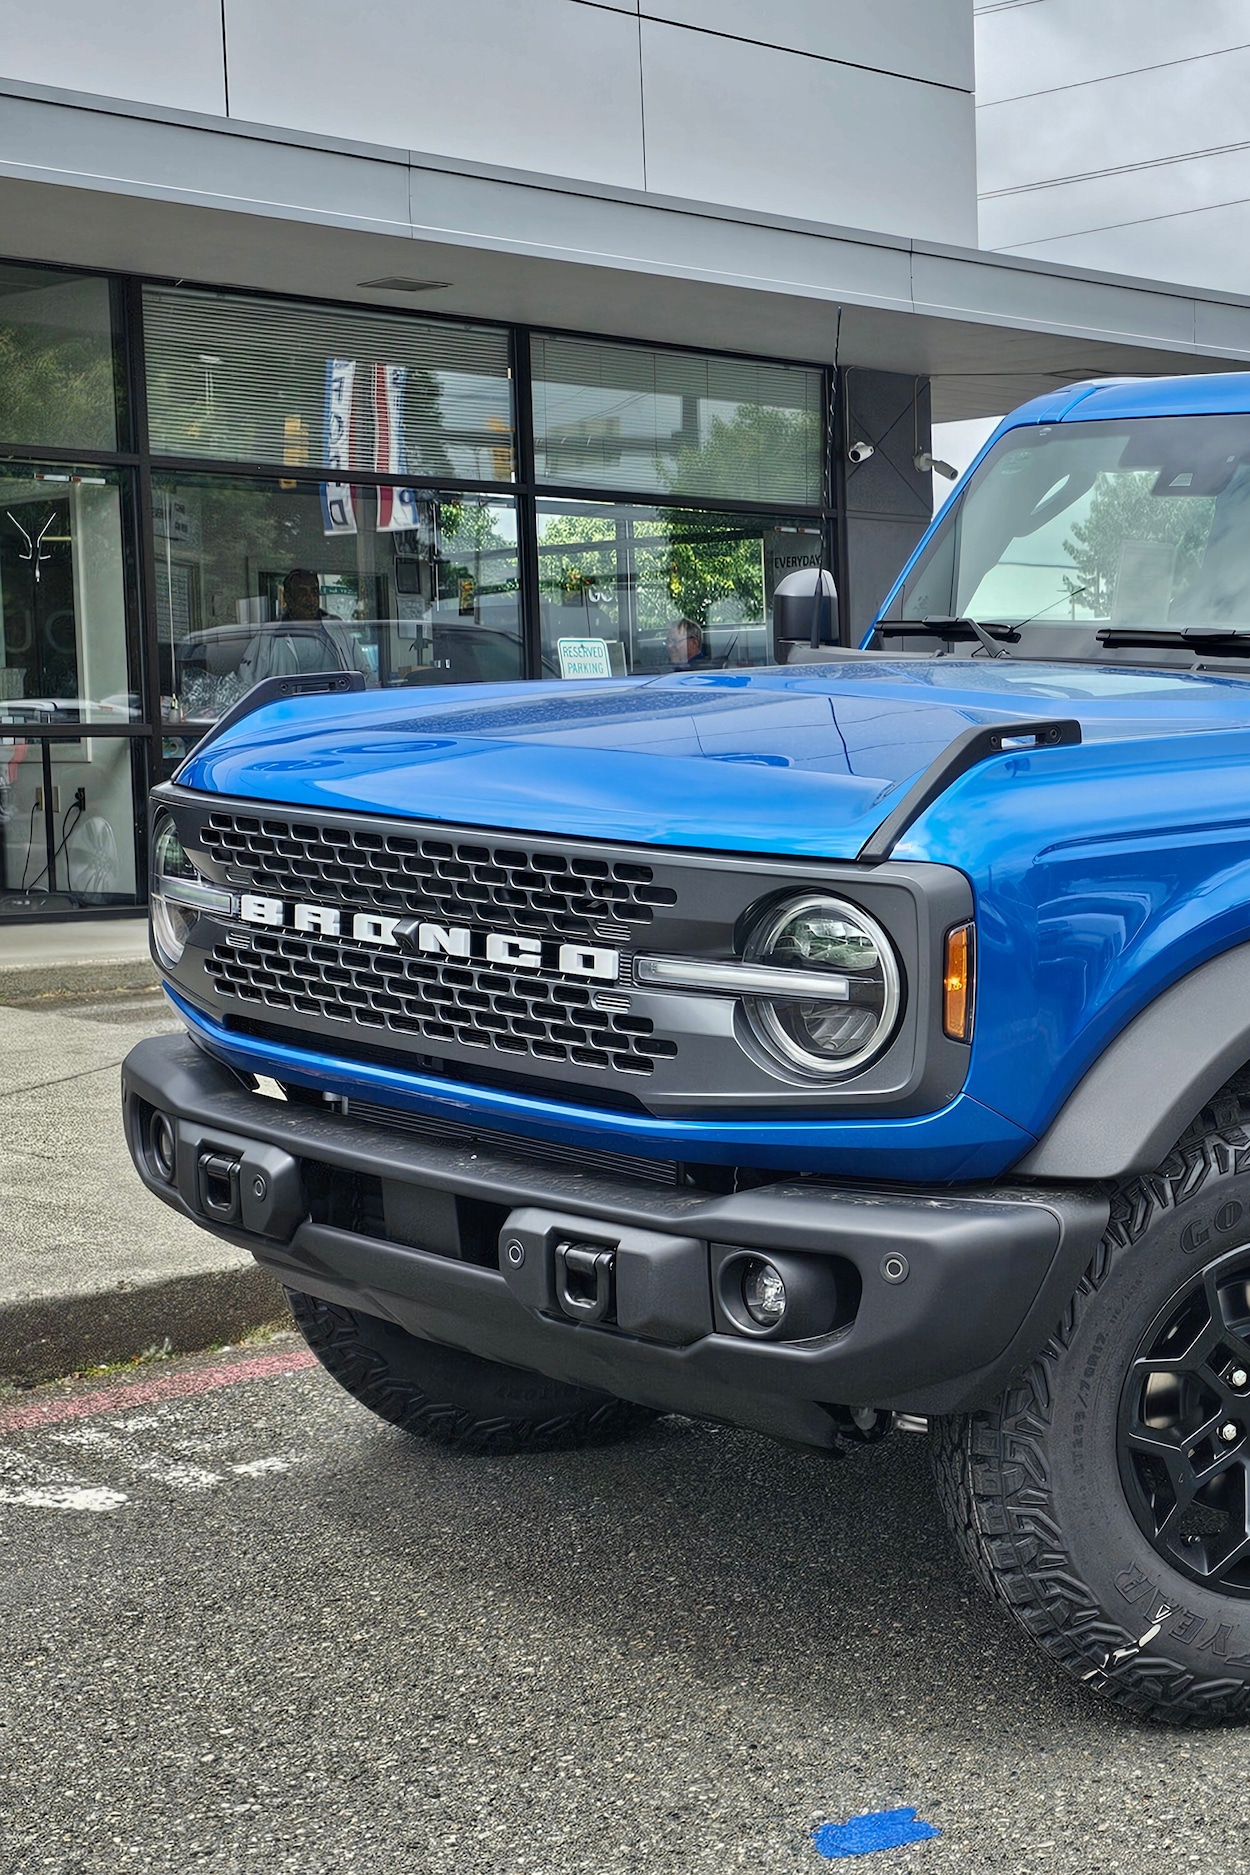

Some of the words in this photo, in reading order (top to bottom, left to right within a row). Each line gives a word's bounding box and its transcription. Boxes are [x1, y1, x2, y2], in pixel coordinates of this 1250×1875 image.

[562, 645, 604, 658] RESERVED
[567, 662, 604, 675] PARKING
[239, 893, 619, 981] BRONCO
